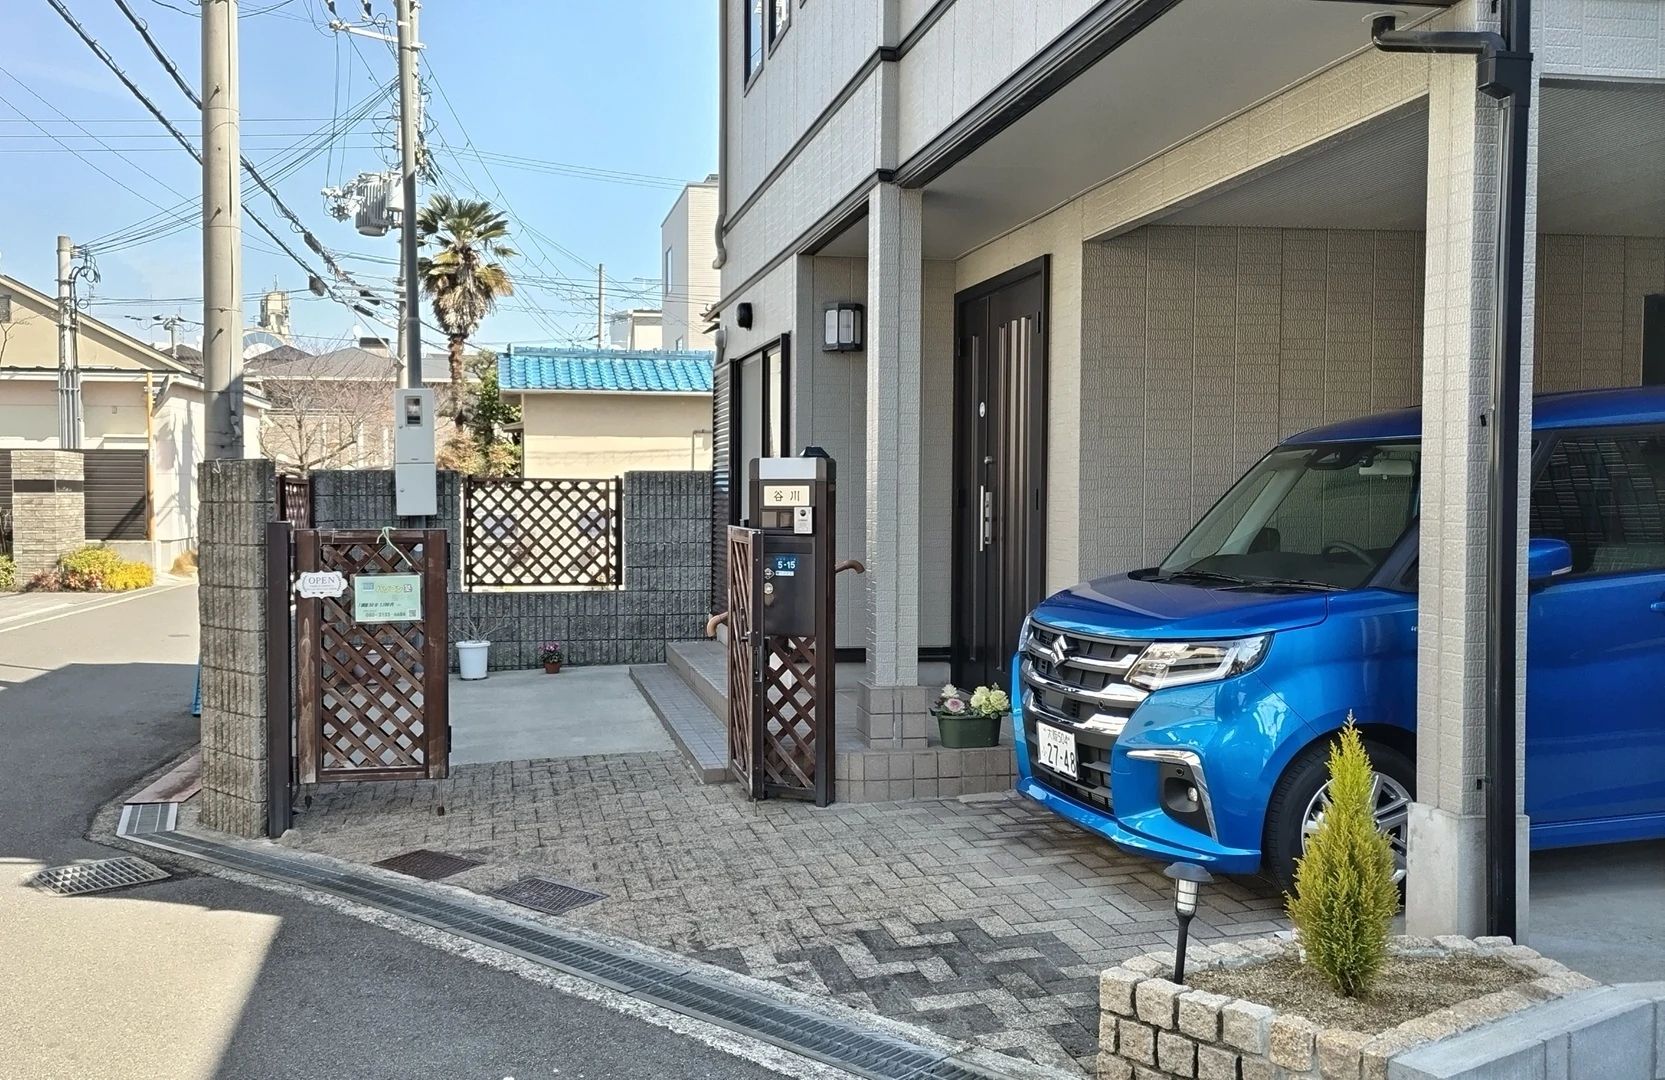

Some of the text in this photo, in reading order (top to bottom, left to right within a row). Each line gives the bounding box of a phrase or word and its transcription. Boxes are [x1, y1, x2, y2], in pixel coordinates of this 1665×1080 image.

[774, 490, 800, 502] 谷川
[777, 560, 796, 569] 5-15
[308, 576, 336, 585] OPEN
[1047, 743, 1076, 773] 27-48
